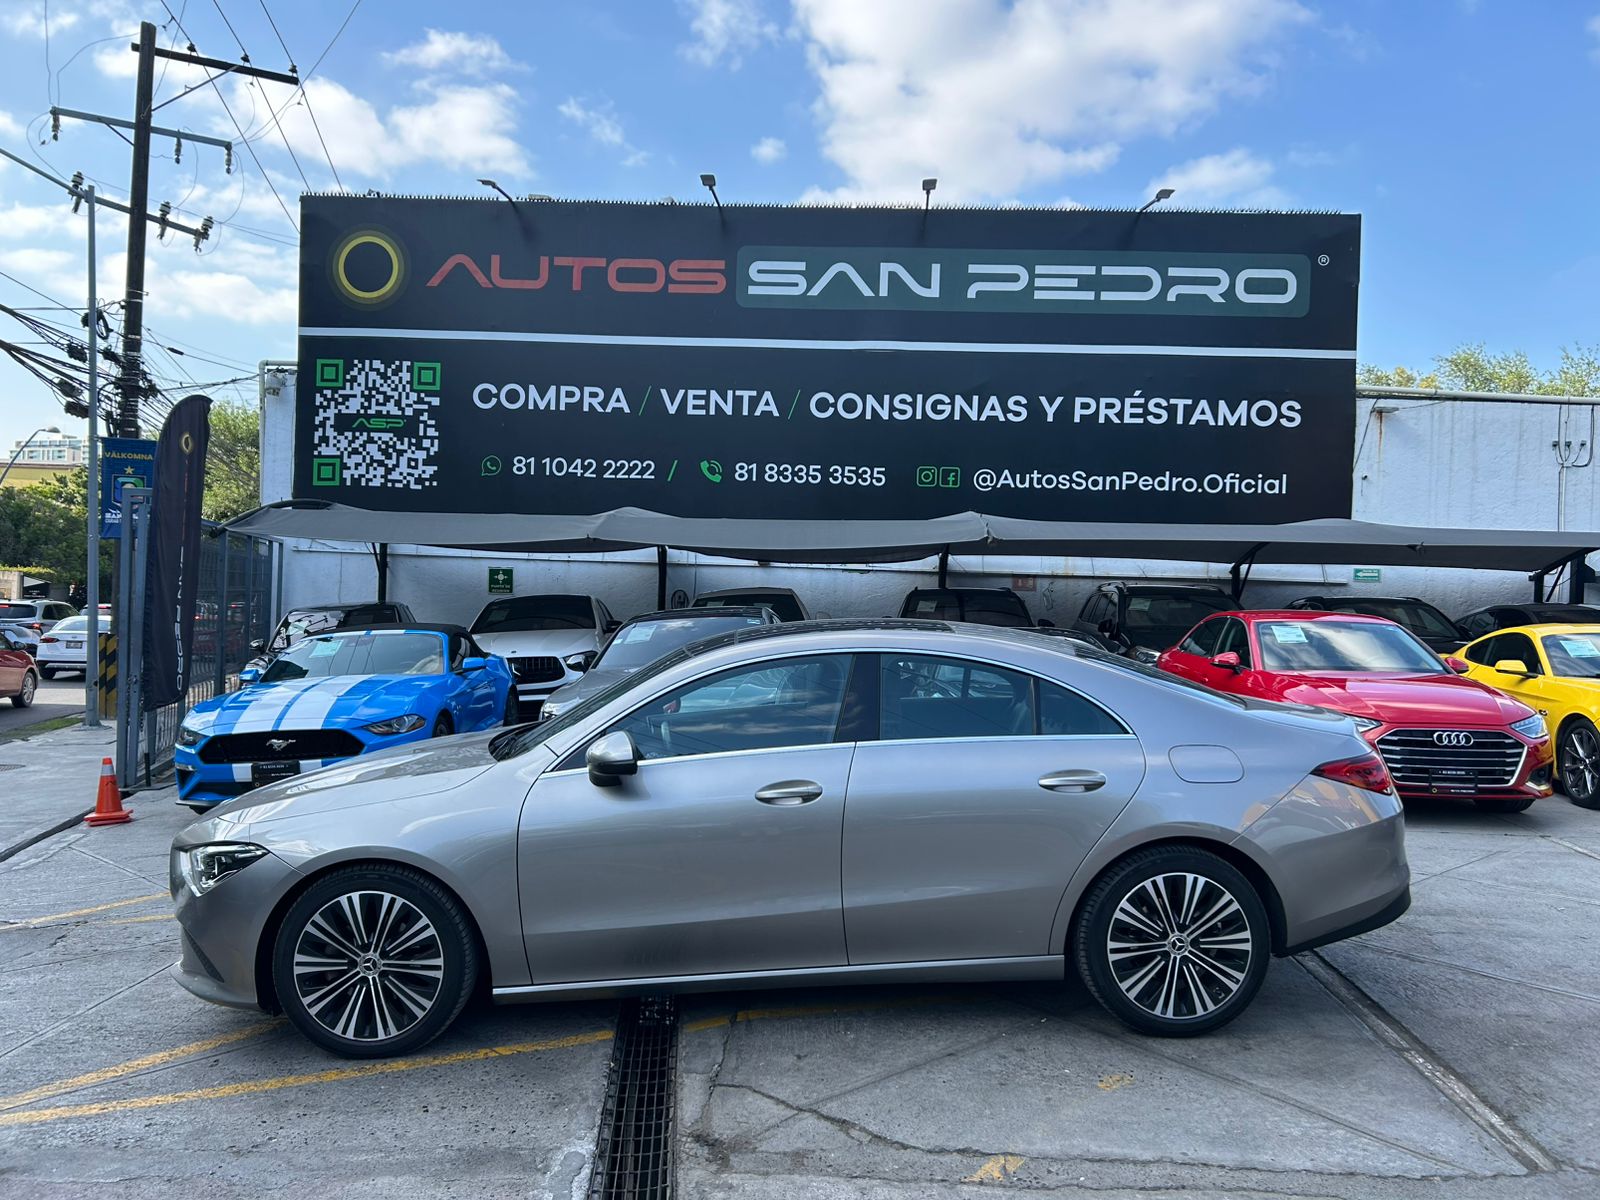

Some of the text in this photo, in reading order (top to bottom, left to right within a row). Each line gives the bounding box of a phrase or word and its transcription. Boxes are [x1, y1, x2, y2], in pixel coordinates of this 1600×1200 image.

[426, 253, 727, 294] AUTOS
[747, 260, 941, 298] SAN
[966, 264, 1298, 304] PEDRO
[472, 383, 631, 414] COMPRA
[660, 388, 780, 417] VENTA
[809, 391, 1028, 422] CONSIGNAS
[1038, 395, 1065, 422] Y
[1073, 390, 1302, 428] PRÉSTAMOS
[512, 456, 535, 475] 81
[541, 457, 597, 478] 1042
[602, 459, 656, 480] 2222
[734, 462, 757, 482] 81
[764, 463, 822, 484] 8335
[828, 465, 887, 487] 3535
[972, 468, 1288, 495] @AutosSanPedro.Oficial
